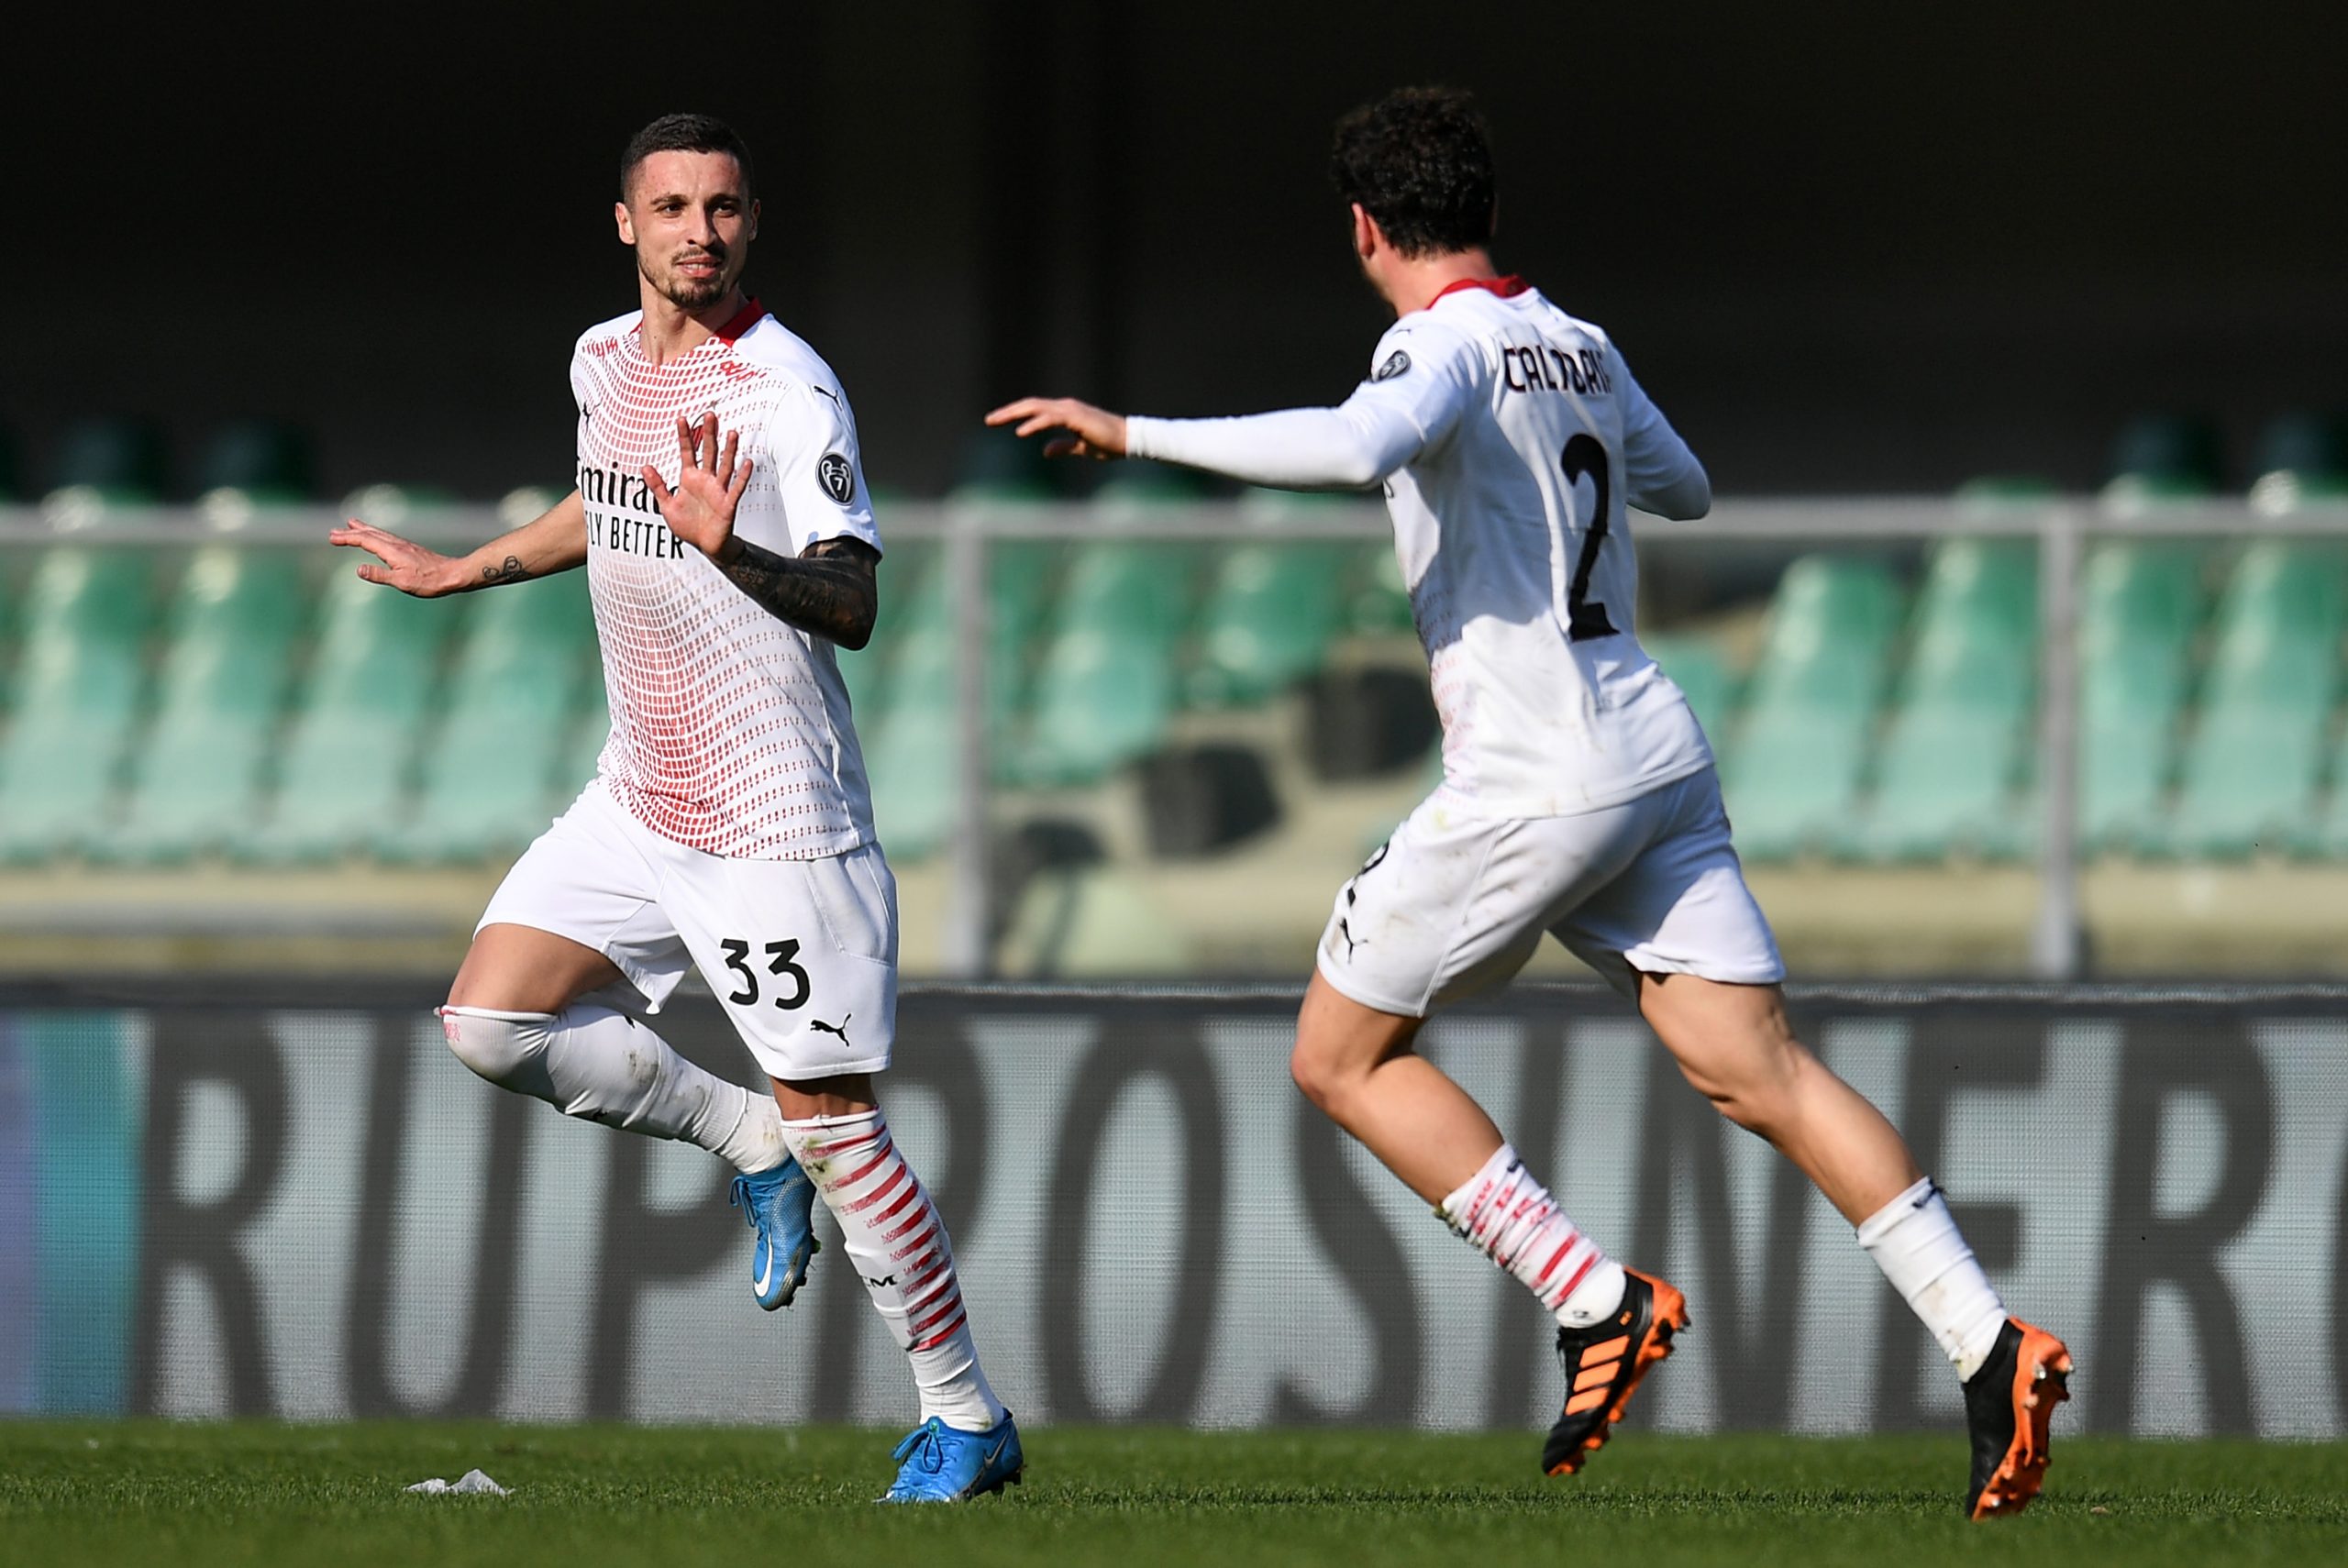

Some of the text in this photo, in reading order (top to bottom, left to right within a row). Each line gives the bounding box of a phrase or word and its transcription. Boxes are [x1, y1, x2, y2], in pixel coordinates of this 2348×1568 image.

[834, 476, 844, 491] 7
[610, 516, 684, 559] BETTER
[1561, 434, 1621, 641] 2
[720, 938, 811, 1010] 33
